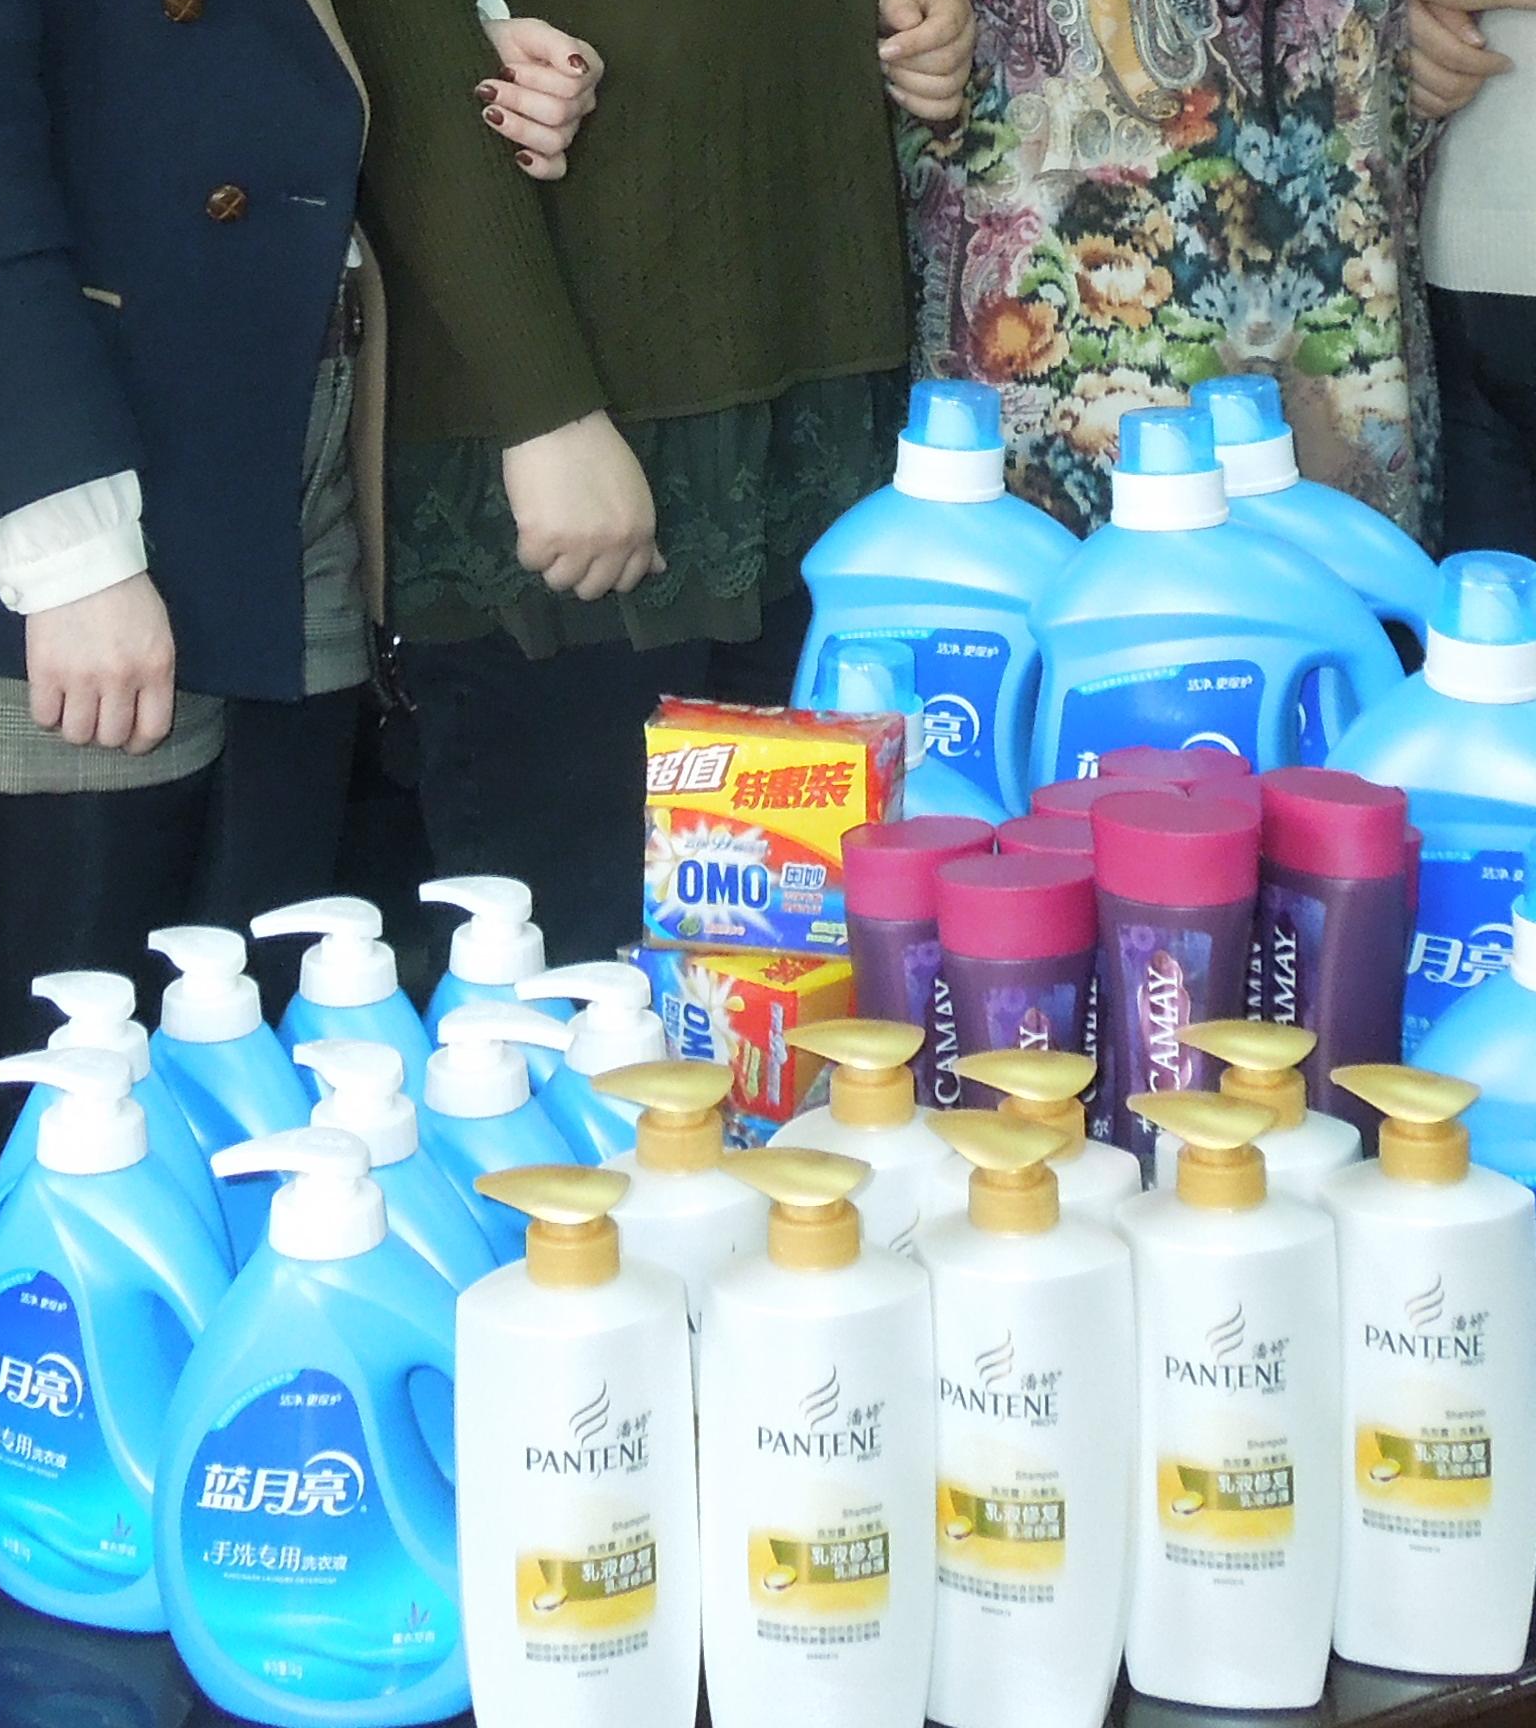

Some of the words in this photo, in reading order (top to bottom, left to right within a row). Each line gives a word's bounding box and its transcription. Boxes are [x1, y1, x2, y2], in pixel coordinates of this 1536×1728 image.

[646, 744, 737, 795] 超值
[732, 762, 857, 810] 特惠装
[677, 859, 770, 911] OMO
[1273, 925, 1297, 1025] AMAY
[681, 1002, 715, 1060] OM
[1149, 967, 1181, 1093] CAMAY
[1364, 1324, 1485, 1364] PANTENE
[940, 1376, 1058, 1424] PANTENE
[1164, 1355, 1286, 1396] PANTENE
[526, 1435, 649, 1479] PANTENE
[757, 1425, 882, 1464] PANTENE
[196, 1450, 365, 1517] 蓝月亮
